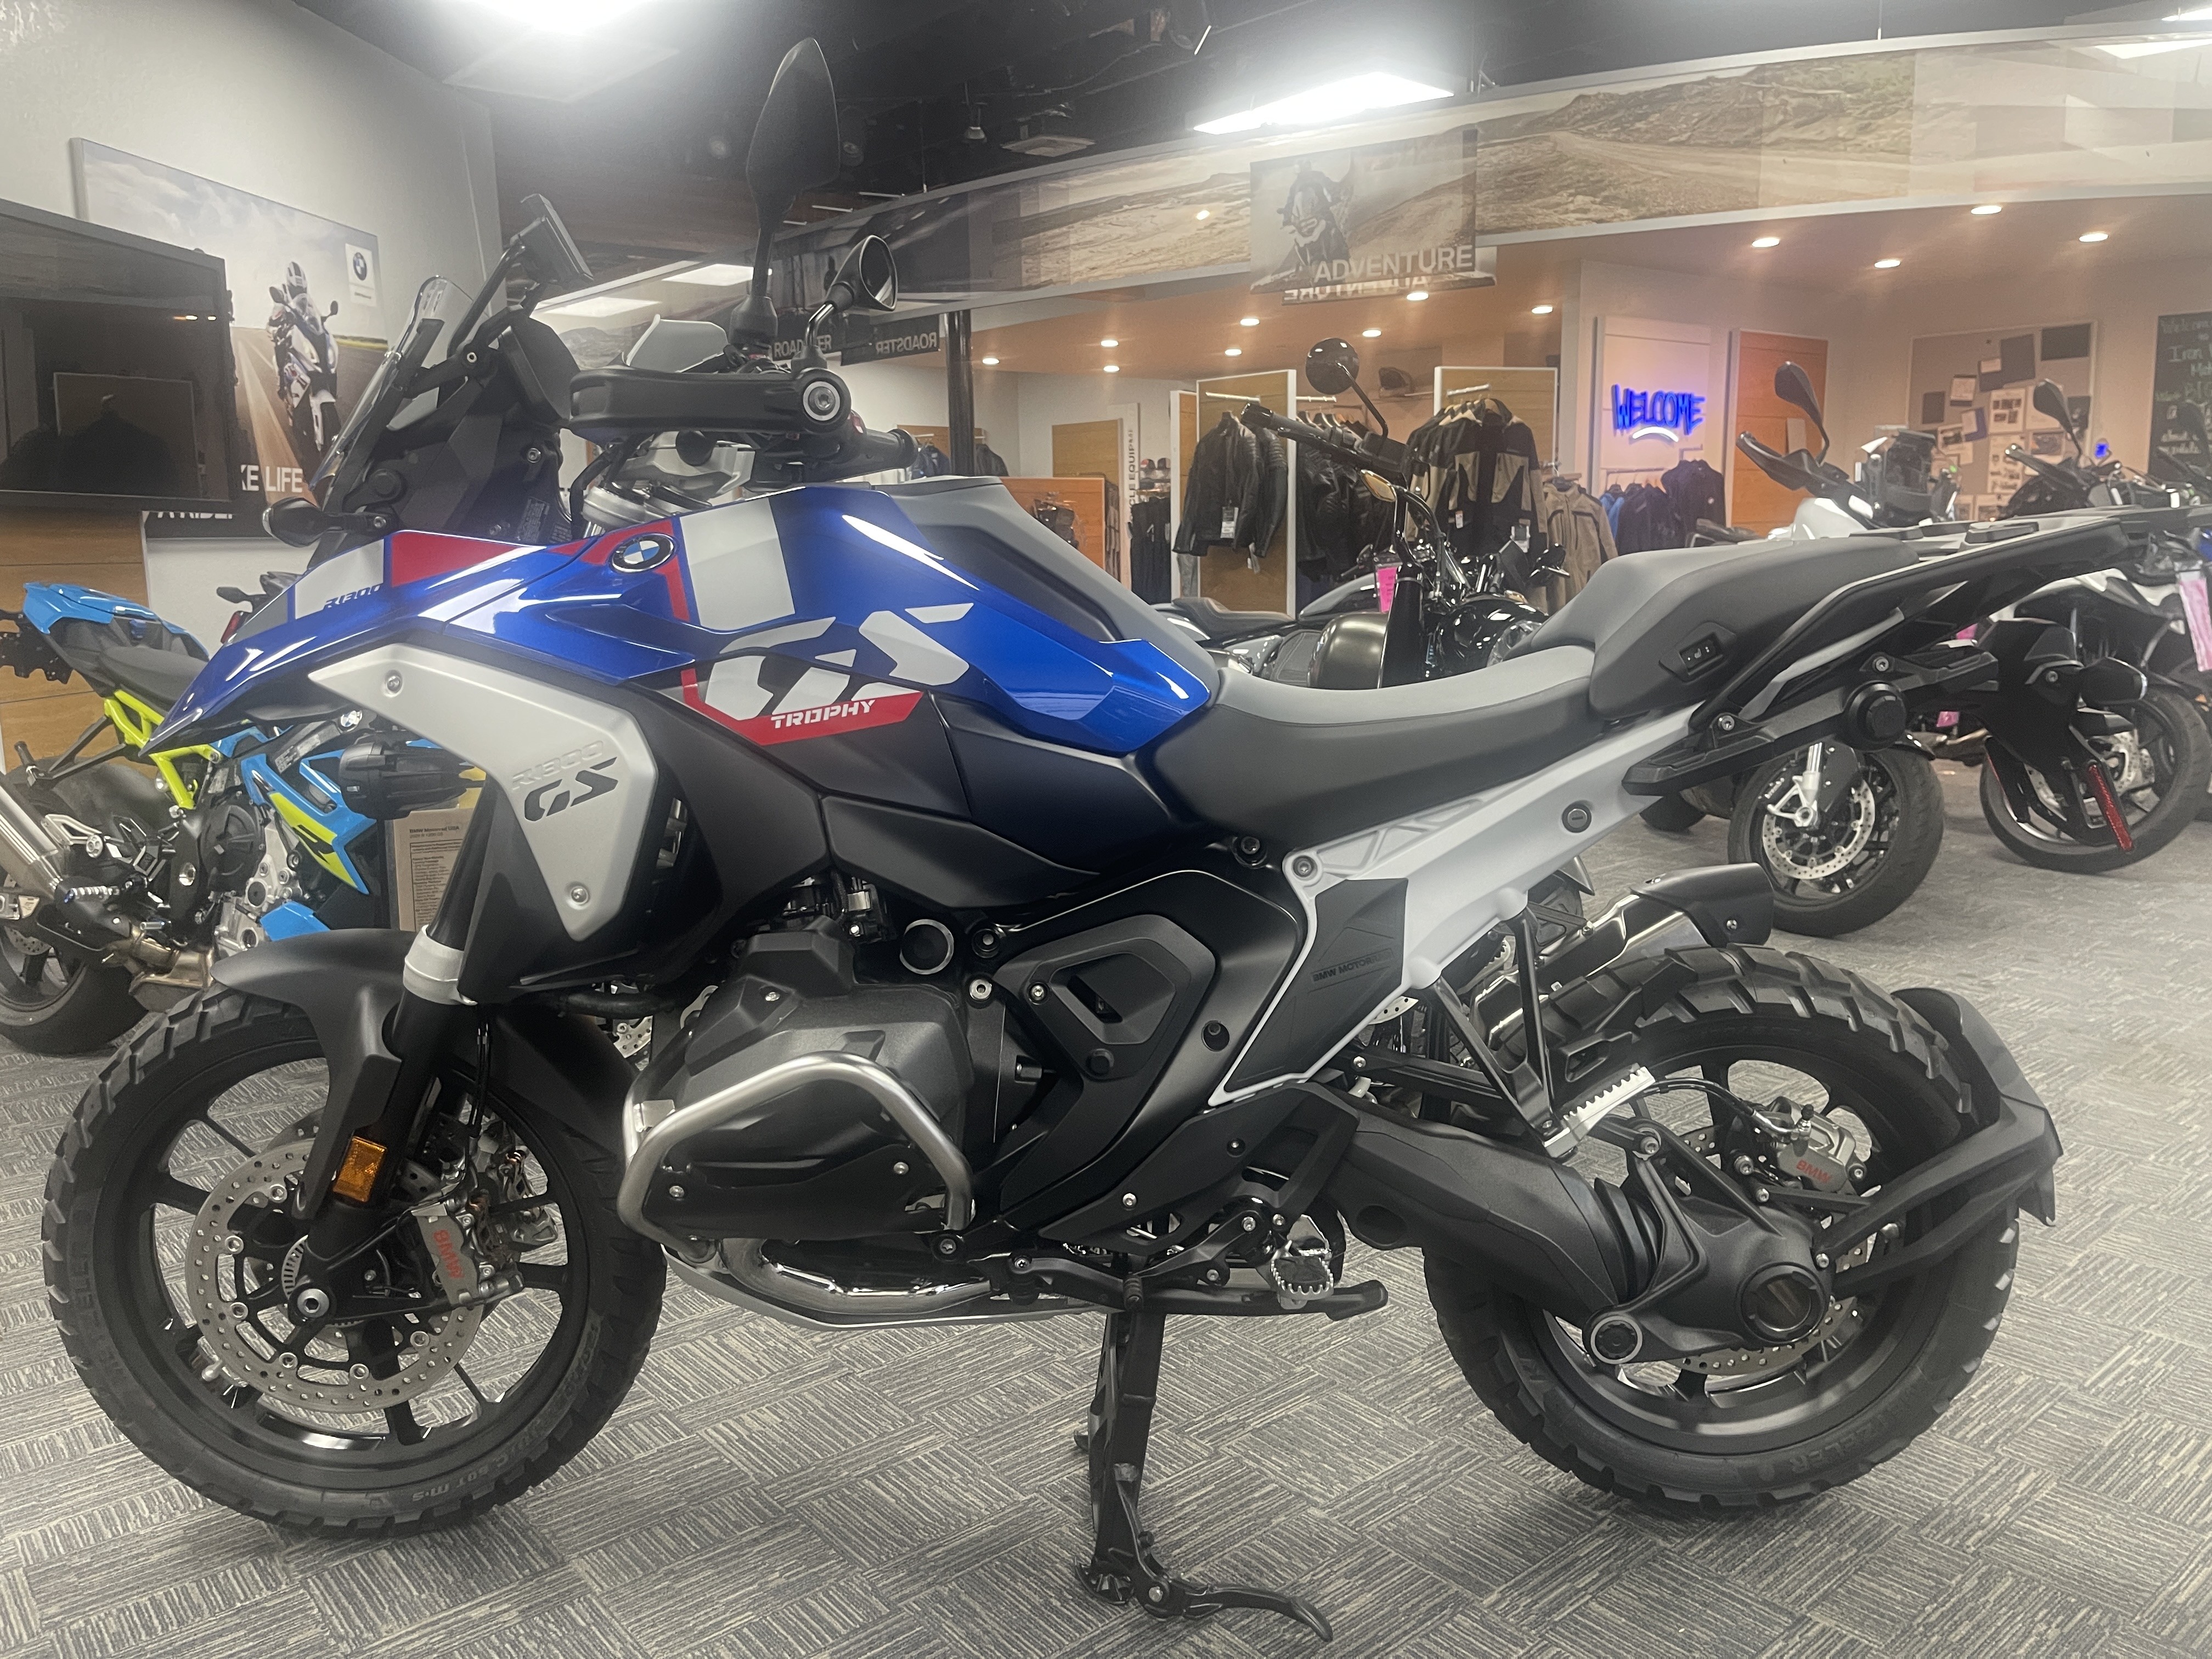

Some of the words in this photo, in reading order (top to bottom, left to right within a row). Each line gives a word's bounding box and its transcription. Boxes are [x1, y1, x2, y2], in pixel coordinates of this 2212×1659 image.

[1314, 245, 1474, 284] ADVENTURE
[774, 334, 832, 357] ROADER
[1612, 383, 1706, 436] WELCOME
[265, 466, 303, 493] LIFE
[704, 602, 974, 721] GS
[771, 699, 876, 729] TROPHY
[524, 757, 619, 822] GS
[1312, 968, 1336, 982] BMW
[1796, 1159, 1832, 1183] BMW
[433, 1229, 464, 1279] BMW
